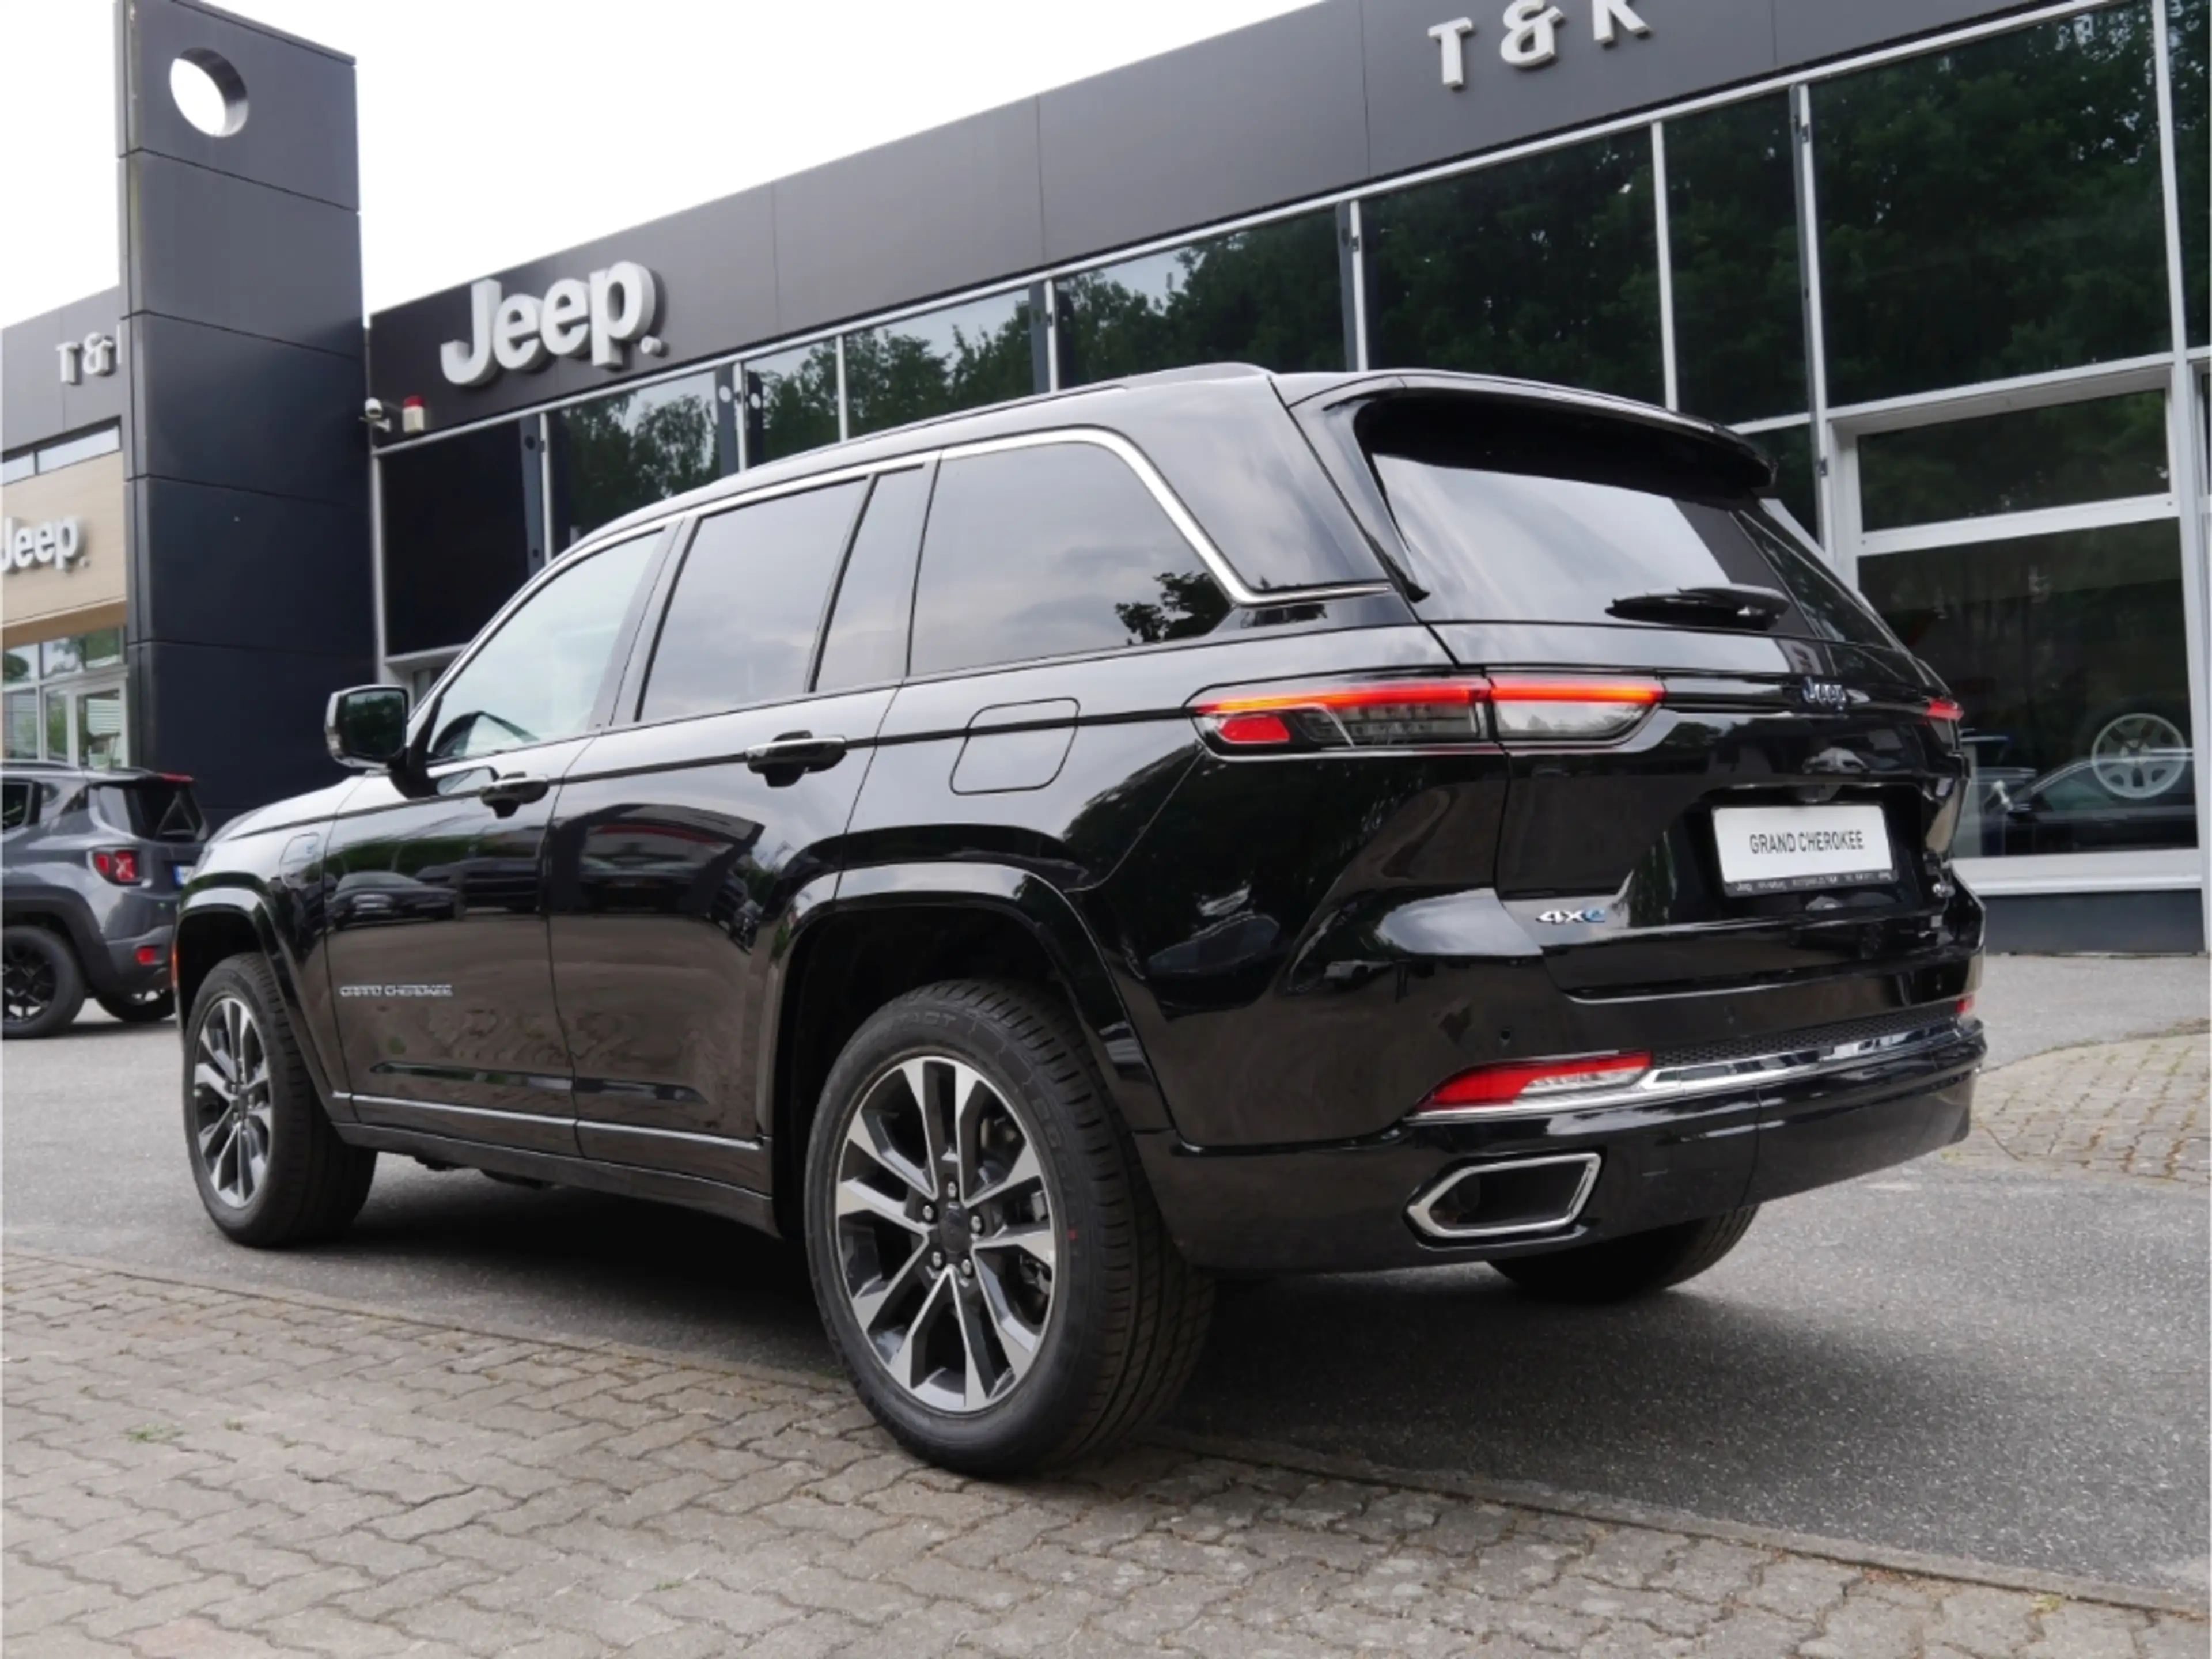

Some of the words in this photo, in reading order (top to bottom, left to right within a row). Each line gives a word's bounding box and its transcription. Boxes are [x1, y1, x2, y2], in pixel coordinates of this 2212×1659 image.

[1428, 17, 1473, 86] T
[1501, 0, 1564, 66] &
[440, 261, 656, 385] Jeep
[1749, 833, 1796, 854] GRAND
[1798, 830, 1864, 853] CHEROKEE
